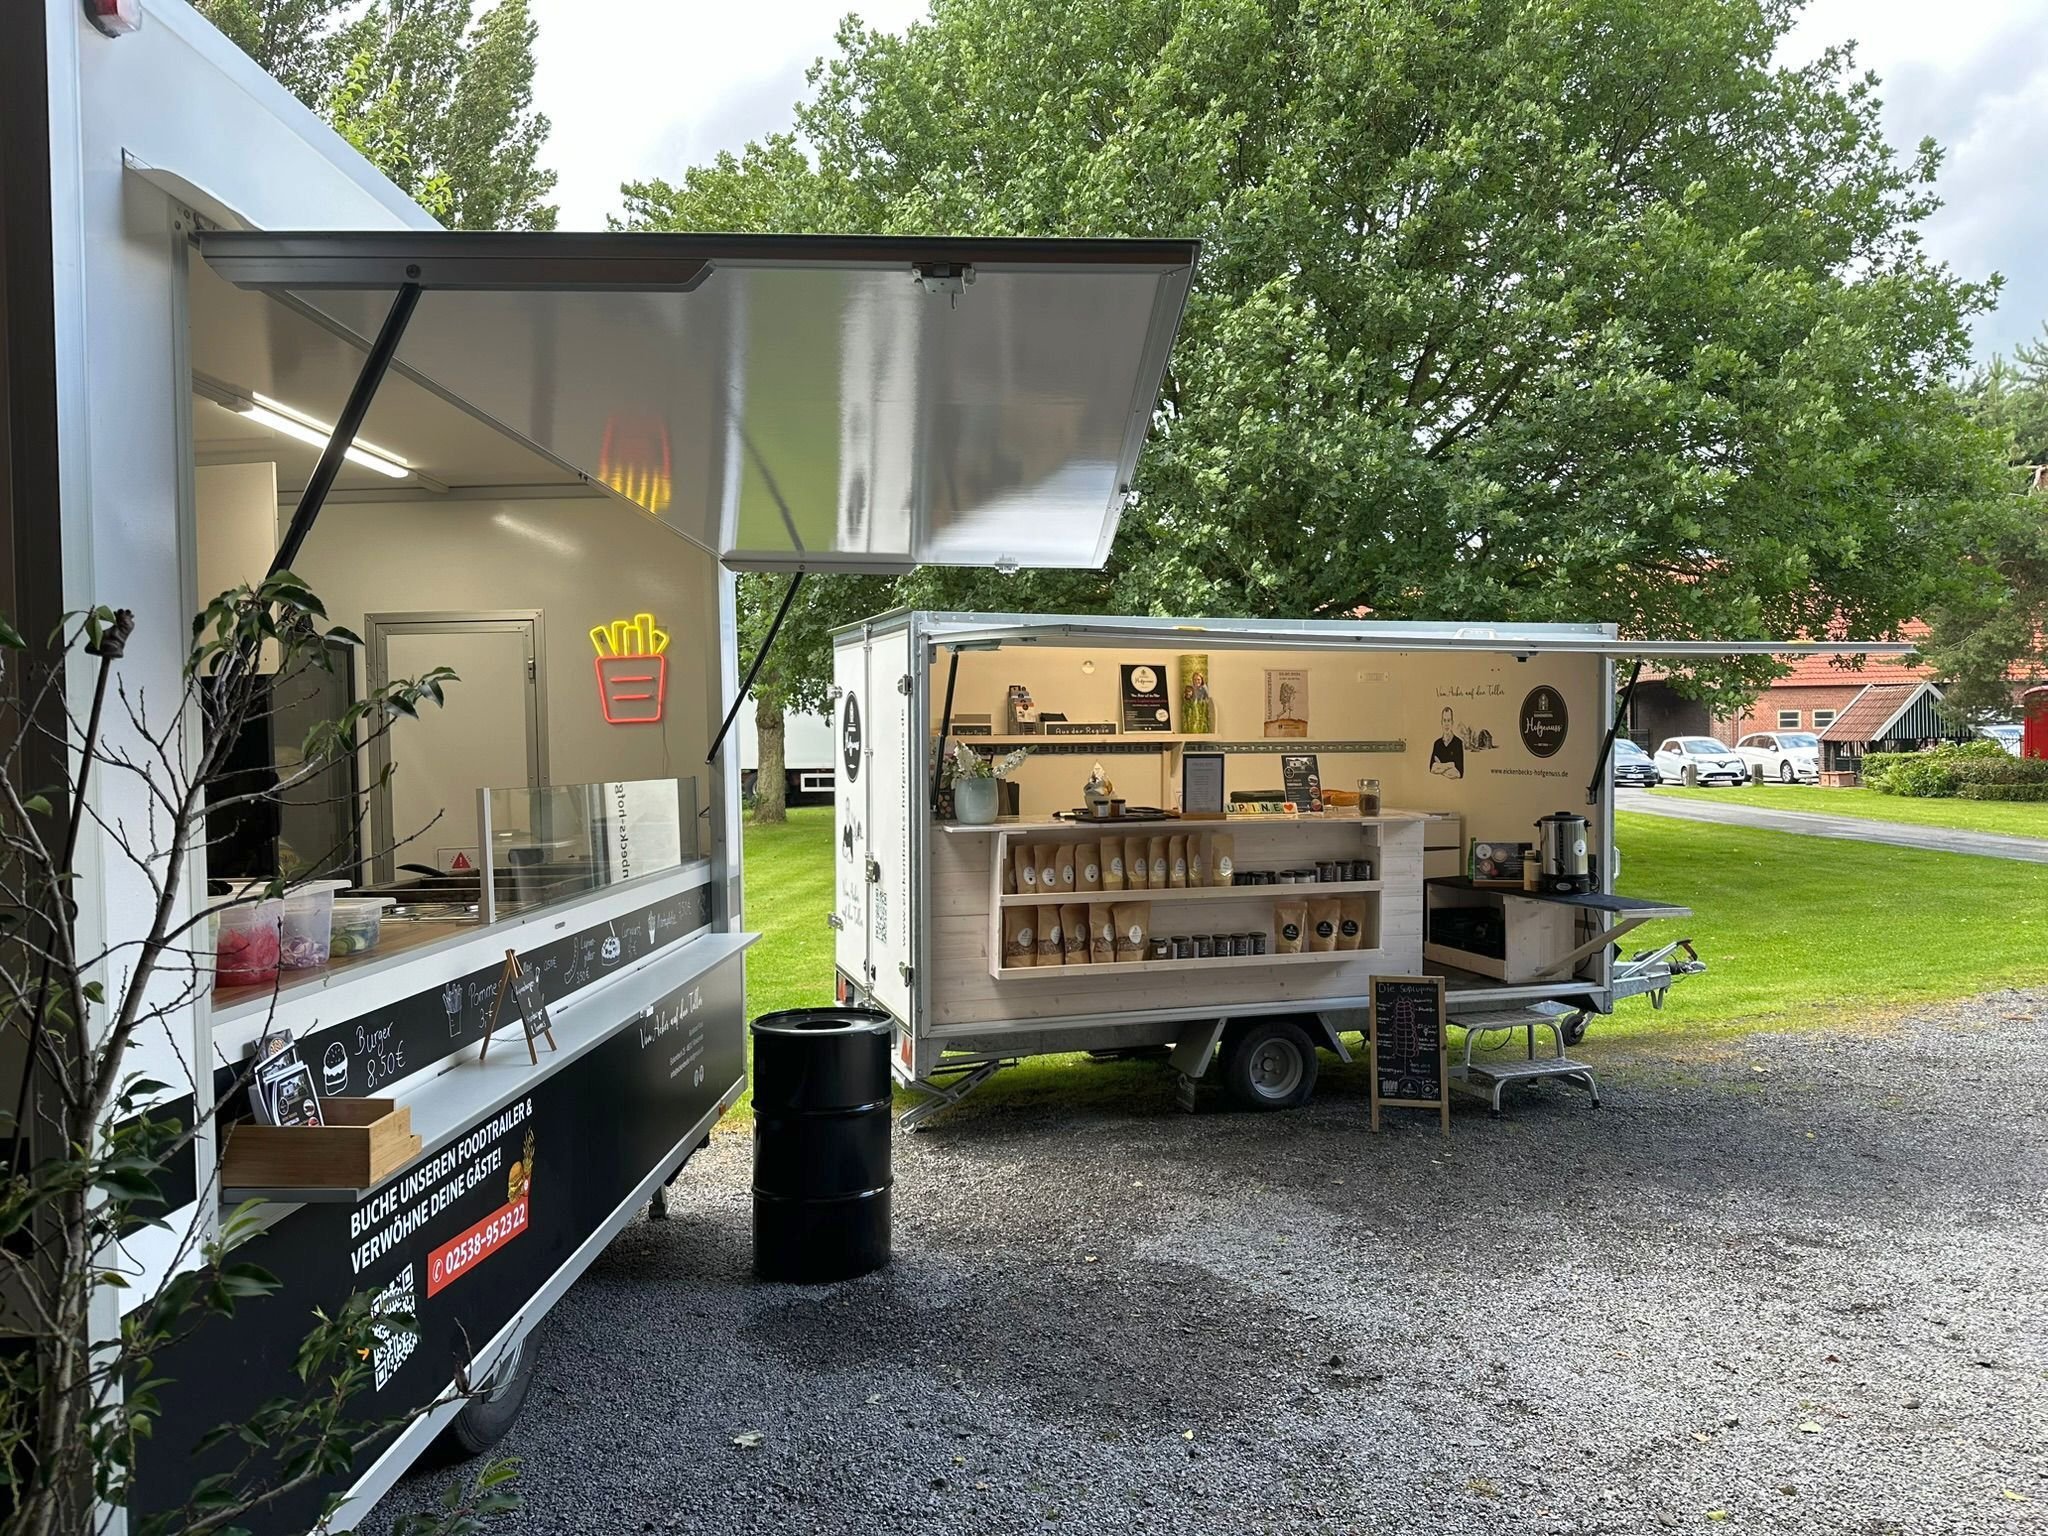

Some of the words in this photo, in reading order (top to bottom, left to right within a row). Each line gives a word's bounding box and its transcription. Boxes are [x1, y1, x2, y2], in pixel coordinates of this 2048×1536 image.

[1085, 726, 1109, 735] Region
[1524, 717, 1562, 737] Hofgenuss
[1490, 768, 1569, 778] www.eickenbecks-hofgenuss.de
[1378, 984, 1395, 993] Die
[354, 1021, 394, 1057] Burger
[367, 1040, 407, 1088] 8,50€
[351, 1186, 398, 1239] BUCHE
[400, 1147, 456, 1204] UNSEREN
[458, 1105, 525, 1165] FOODTRAILER
[526, 1098, 533, 1117] &
[351, 1203, 429, 1275] VERWÖHNE
[431, 1173, 465, 1217] DEINE
[466, 1146, 502, 1190] GÄSTE!
